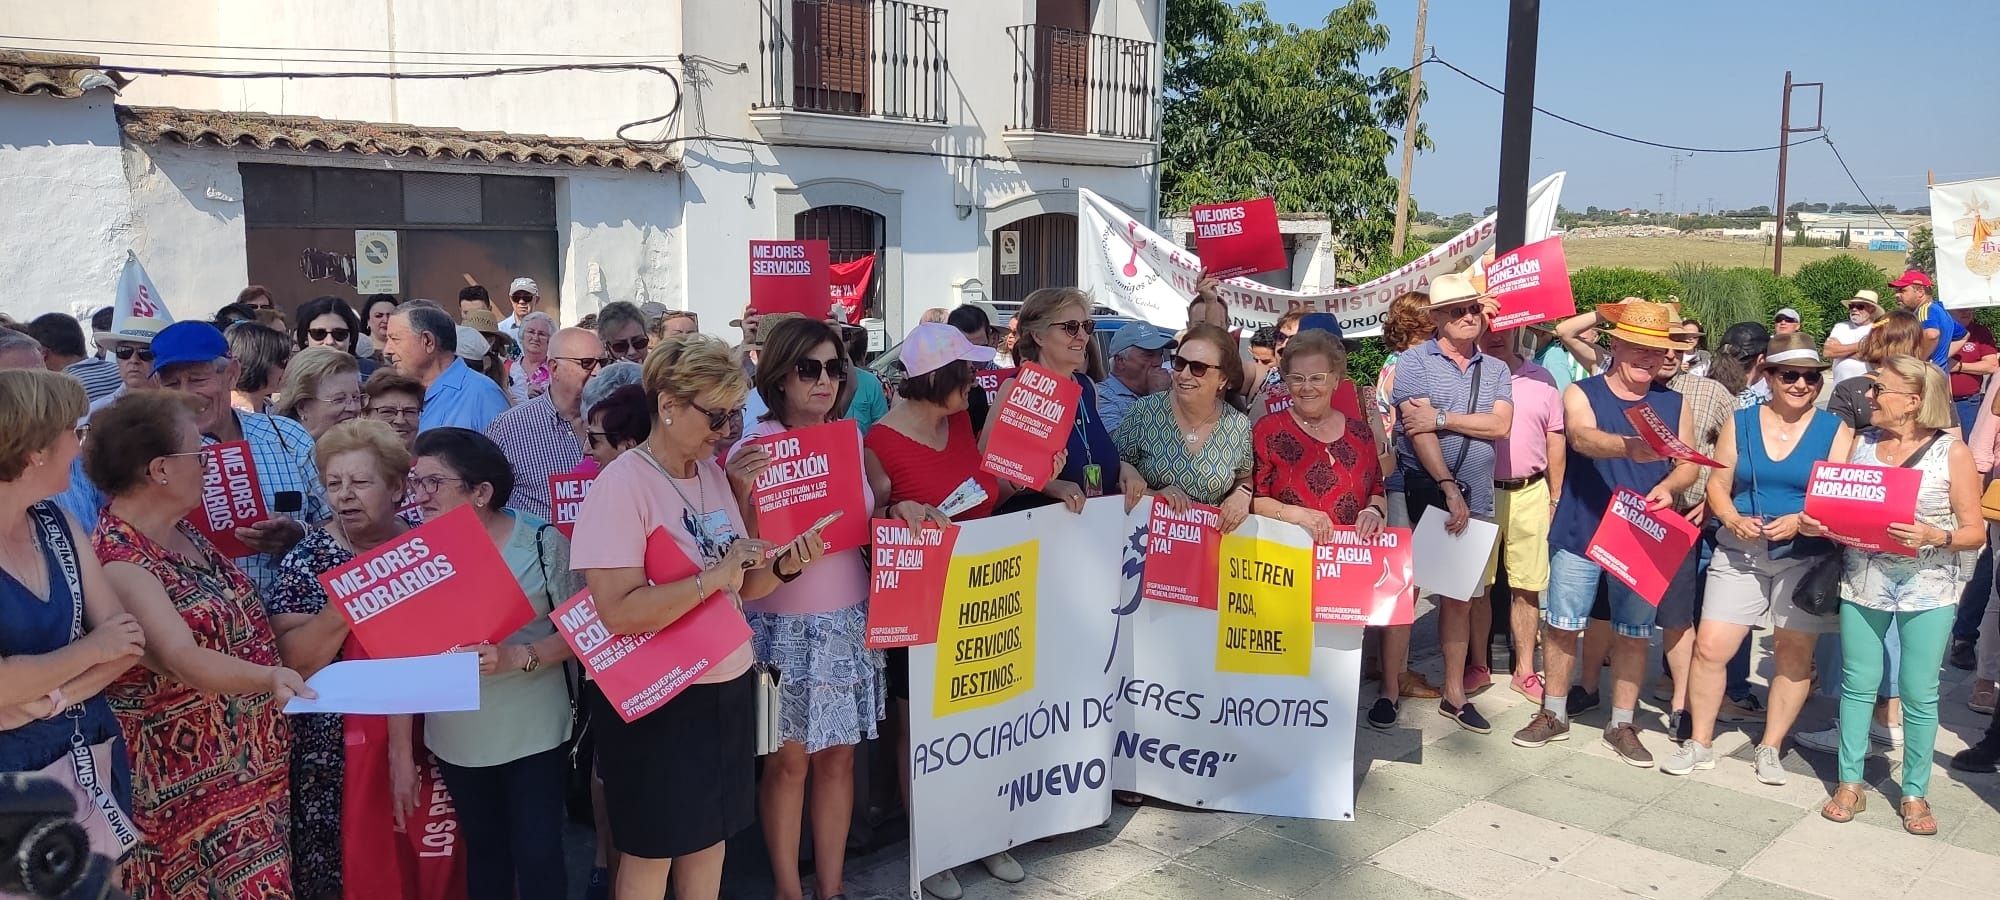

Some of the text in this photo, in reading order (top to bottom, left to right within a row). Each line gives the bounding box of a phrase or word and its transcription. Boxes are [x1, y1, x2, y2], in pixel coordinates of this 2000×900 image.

[1195, 206, 1246, 223] MEJORES
[1197, 221, 1243, 237] TARIFAS
[752, 245, 805, 259] MEJORES
[1487, 253, 1519, 277] MEJOR
[752, 260, 811, 274] SERVICIOS
[1487, 258, 1541, 286] CONEXIÓN
[1325, 274, 1430, 313] HISTORIA
[1018, 368, 1058, 397] MEJOR
[1010, 387, 1066, 421] CONEXIÓN
[1015, 412, 1023, 420] LA
[1024, 423, 1030, 432] LA
[220, 446, 258, 519] MEJORES
[1815, 466, 1884, 484] MEJORES
[758, 481, 828, 506] ENTRE LA ESTACIÓN Y LOS
[760, 489, 828, 514] PUEBLOS DE LA COMARCA
[1616, 490, 1647, 511] MÁS
[1811, 481, 1887, 500] HORARIOS
[1152, 519, 1201, 541] DE AGUA
[1611, 500, 1667, 541] PARADAS
[876, 548, 923, 568] DE AGUA
[1150, 536, 1172, 555] ¡YA!
[1317, 546, 1372, 563] DE AGUA
[329, 536, 430, 599] MEJORES
[968, 555, 1022, 589] MEJORES
[1230, 557, 1294, 588] SI EL TREN
[1316, 563, 1341, 581] ¡YA!
[343, 553, 455, 622] HORARIOS
[875, 570, 900, 593] ¡YA!
[1228, 592, 1257, 618] PASA,
[1225, 626, 1287, 652] QUE PARE.
[588, 646, 614, 667] ENTRE
[612, 640, 624, 652] LA
[593, 647, 627, 674] PUEBLOS
[625, 640, 637, 654] DE
[634, 637, 647, 647] LA
[621, 665, 684, 711] @SIPASAQUEPARE
[626, 658, 709, 717] #TRENENLOSPEDROCHES
[950, 662, 1022, 699] DESTINOS...
[913, 700, 1070, 781] ASOCIACIÓN
[1083, 691, 1113, 729] DE
[1209, 697, 1329, 728] JAROTAS
[103, 798, 135, 846] BIMBA
[419, 819, 457, 858] LOS
